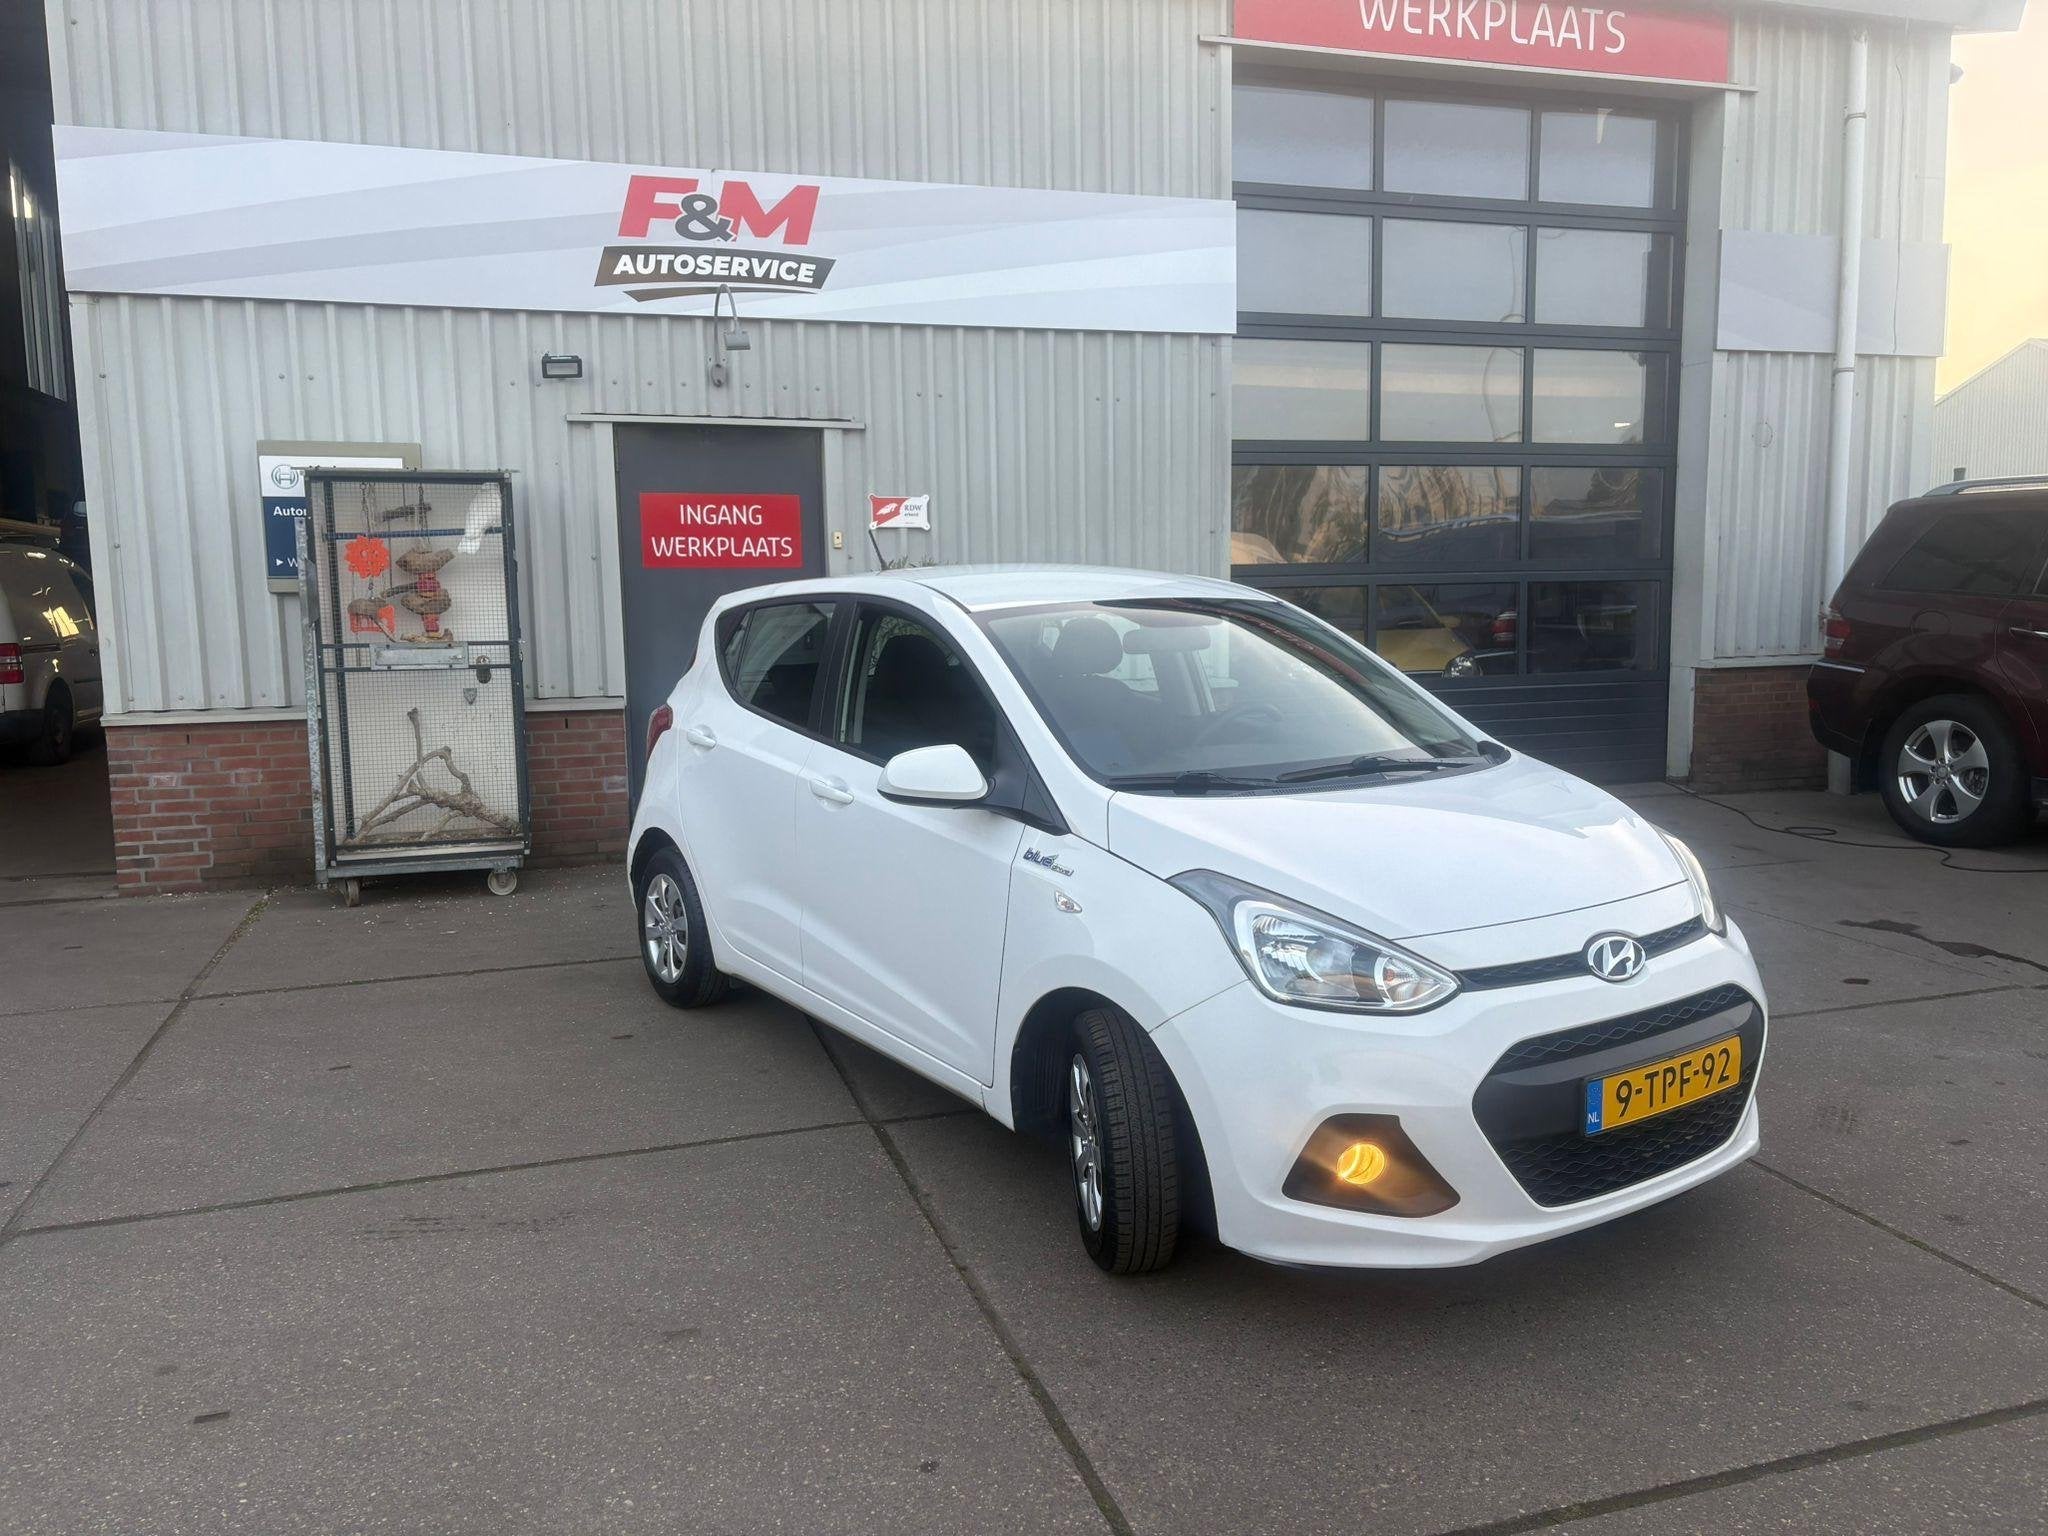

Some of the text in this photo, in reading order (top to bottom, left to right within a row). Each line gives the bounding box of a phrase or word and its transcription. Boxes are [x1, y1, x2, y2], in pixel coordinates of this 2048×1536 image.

[1359, 0, 1626, 54] WERKPLAATS
[617, 174, 821, 246] F&M
[612, 253, 817, 284] AUTOSERVICE
[679, 503, 763, 526] INGANG
[651, 536, 794, 558] WERKPLAATS
[1615, 1047, 1731, 1118] 9-TPF-92
[1587, 1111, 1600, 1125] NL
